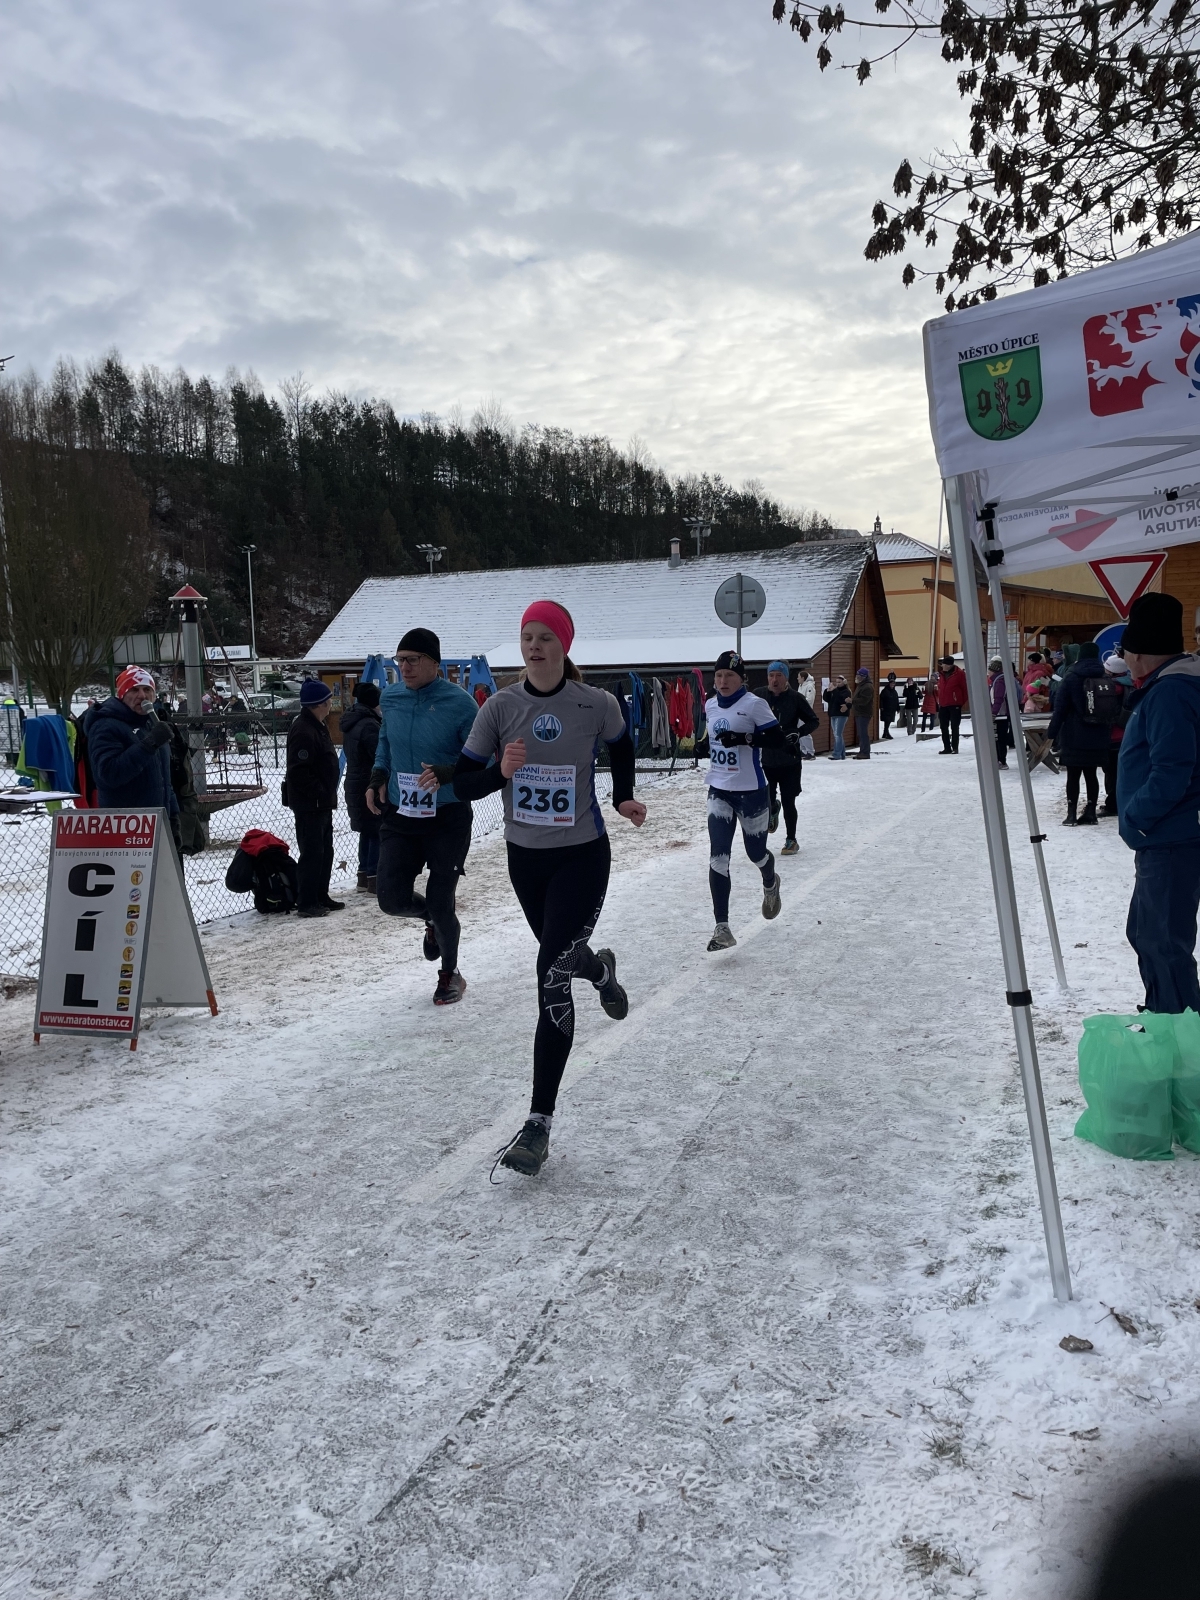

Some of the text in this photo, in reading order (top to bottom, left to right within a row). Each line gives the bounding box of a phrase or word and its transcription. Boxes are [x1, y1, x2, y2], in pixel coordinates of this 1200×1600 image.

[958, 333, 1039, 361] MĚSTO ÚPICE
[711, 749, 737, 765] 208
[401, 789, 434, 808] 244
[517, 785, 570, 813] 236
[57, 815, 156, 834] MARATON
[125, 835, 151, 845] stav
[132, 849, 152, 857] Úpice
[43, 1015, 130, 1028] www.maratonstav.cz
